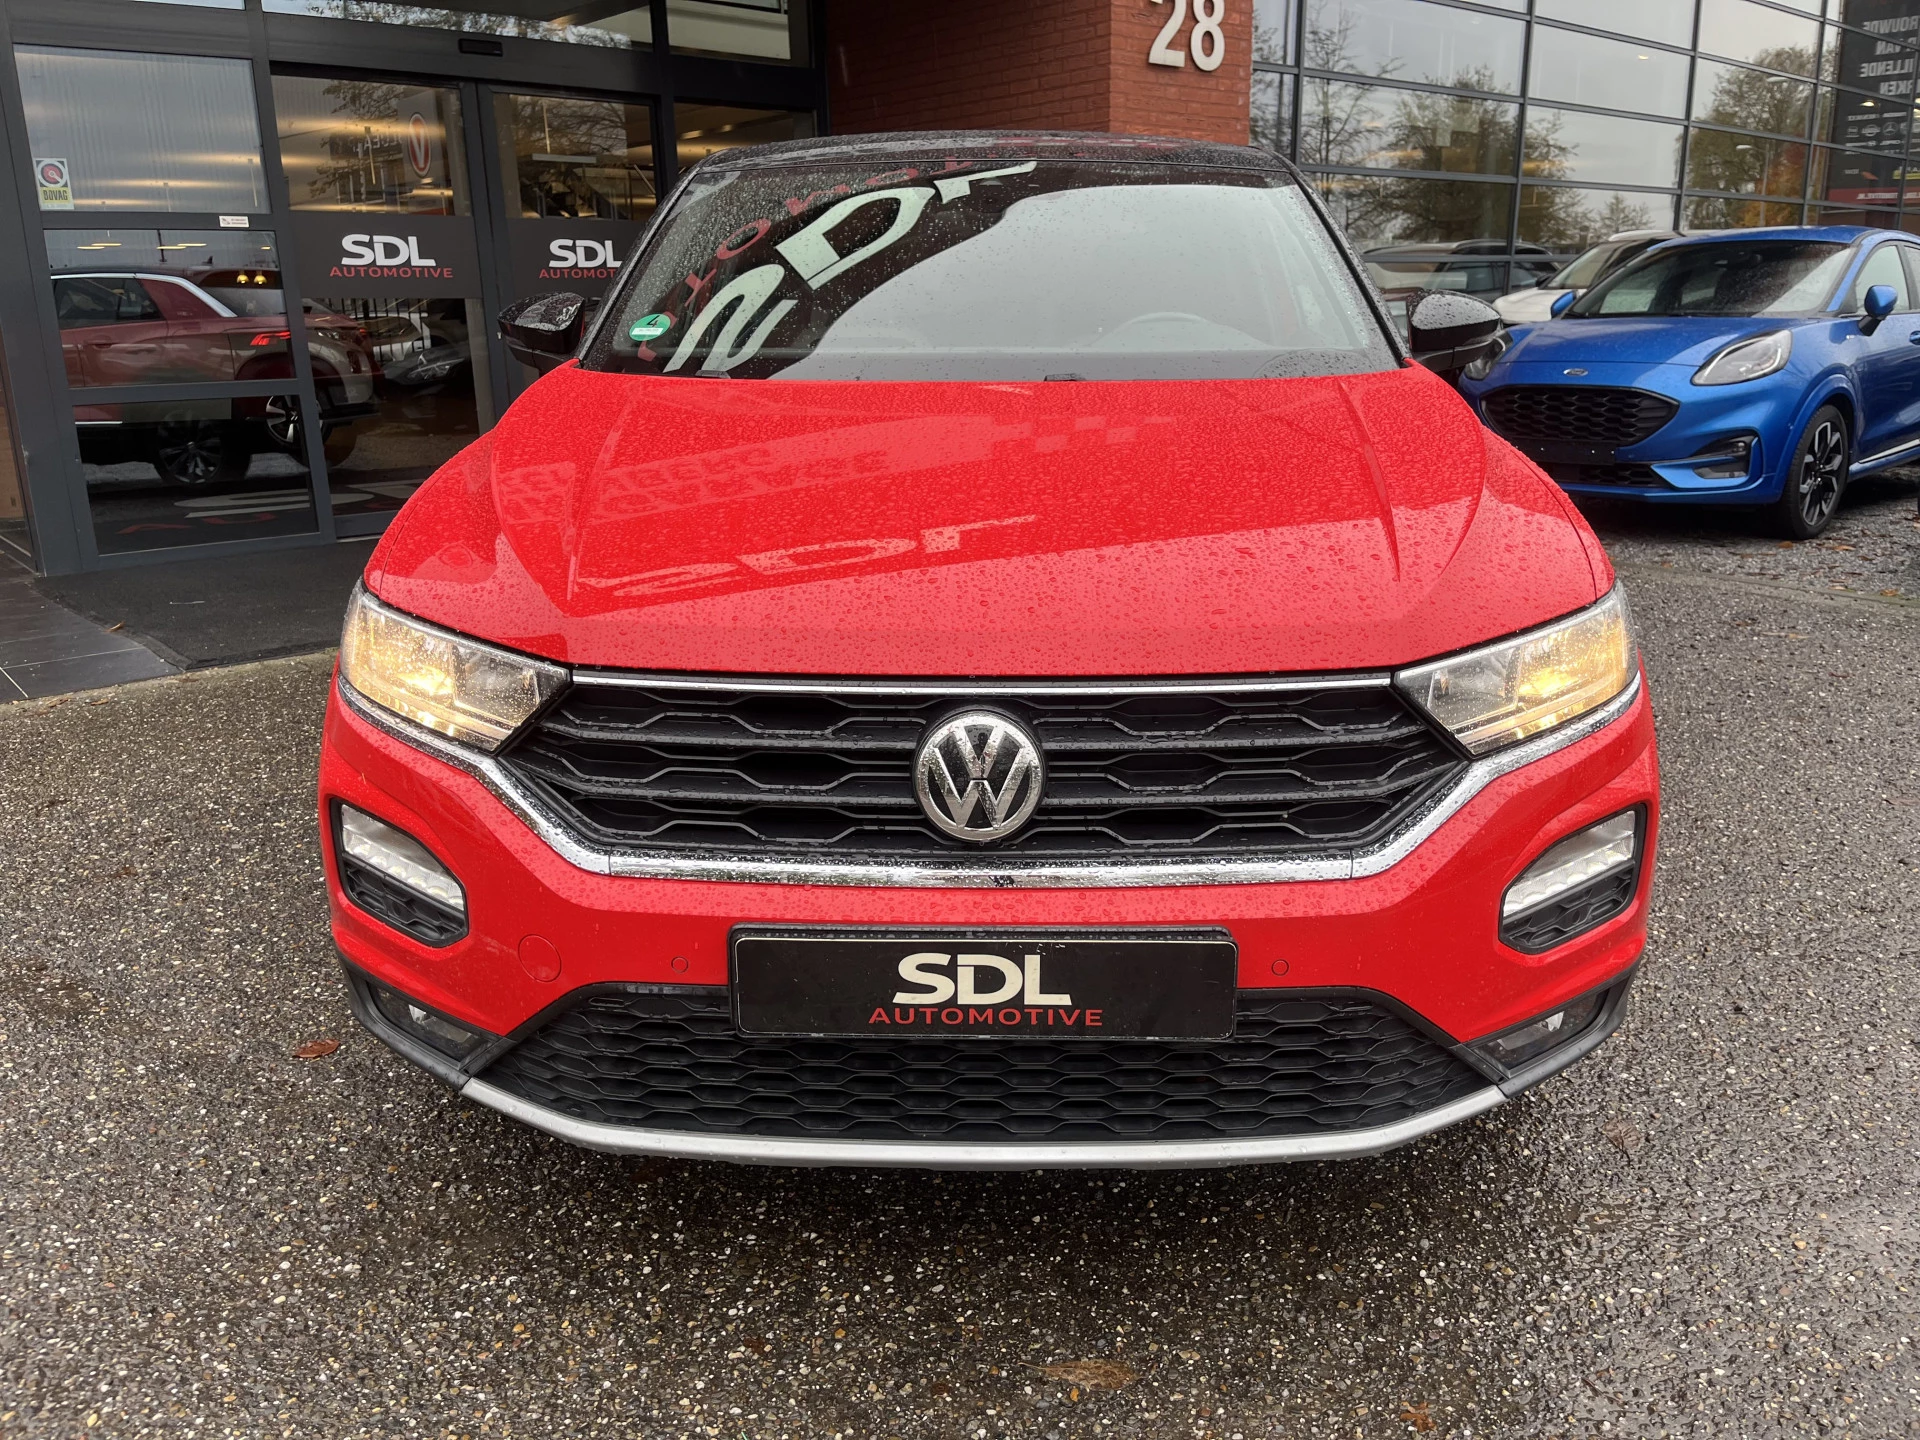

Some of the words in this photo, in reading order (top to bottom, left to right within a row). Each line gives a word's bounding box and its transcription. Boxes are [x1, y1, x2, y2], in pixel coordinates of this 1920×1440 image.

[1148, 0, 1225, 71] 28
[43, 189, 68, 201] BOVAG
[341, 233, 437, 267] SDL
[548, 238, 623, 269] SDL
[329, 265, 454, 279] AUTOMOTIVE
[646, 315, 661, 328] 4
[892, 952, 1073, 1006] SDL
[868, 1006, 1104, 1027] AUTOMOTIVE
